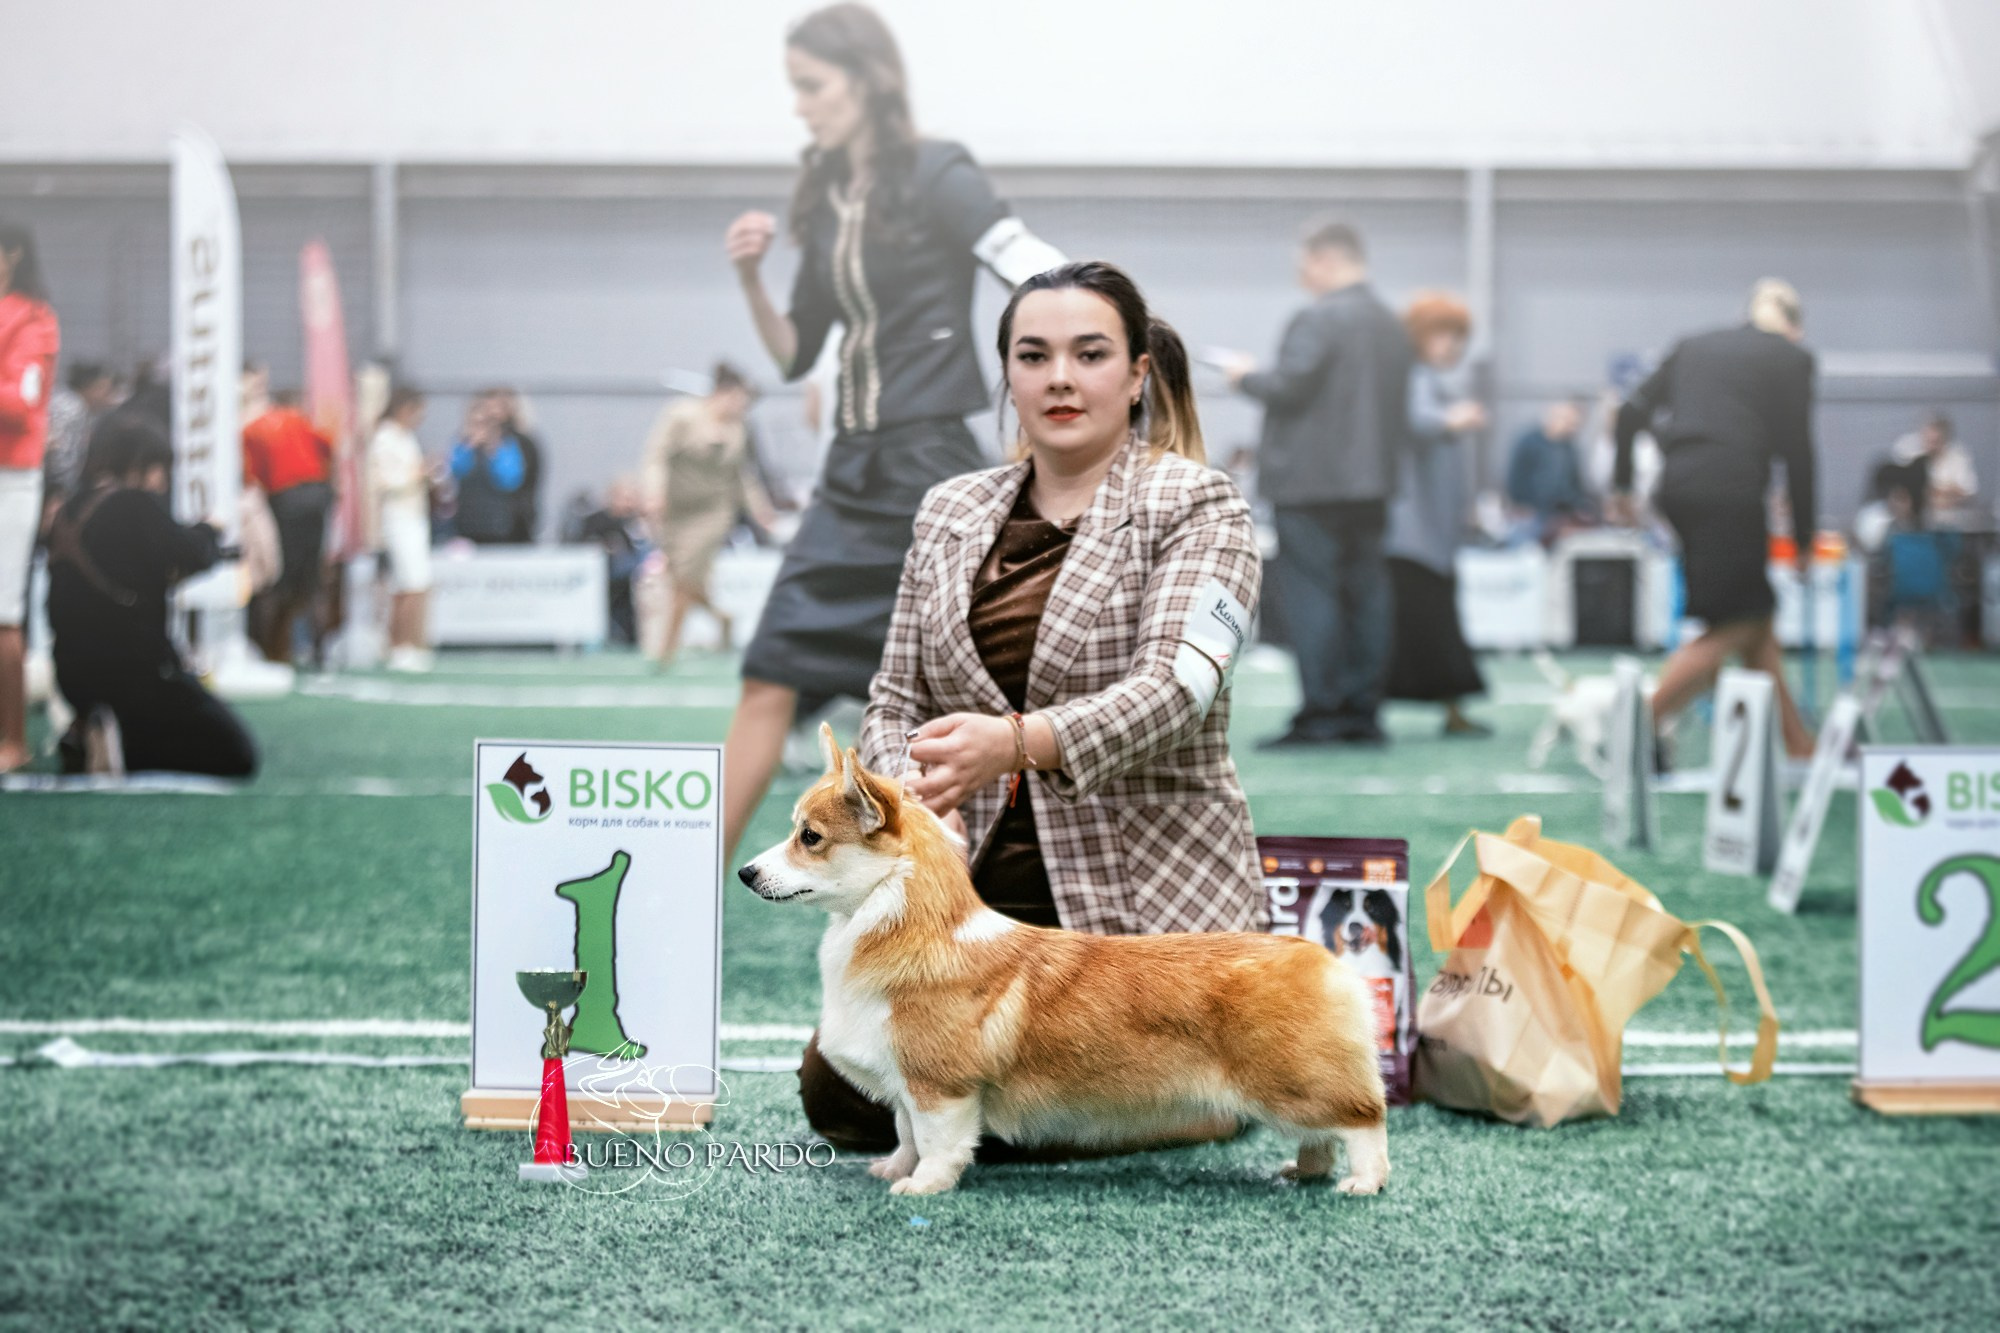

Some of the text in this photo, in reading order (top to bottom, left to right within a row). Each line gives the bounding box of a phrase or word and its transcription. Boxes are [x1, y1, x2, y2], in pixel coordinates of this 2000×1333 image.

[568, 815, 712, 830] корм для собак и кошек
[569, 767, 712, 811] BISKO
[541, 850, 648, 1060] 1
[1914, 852, 2000, 1055] 2
